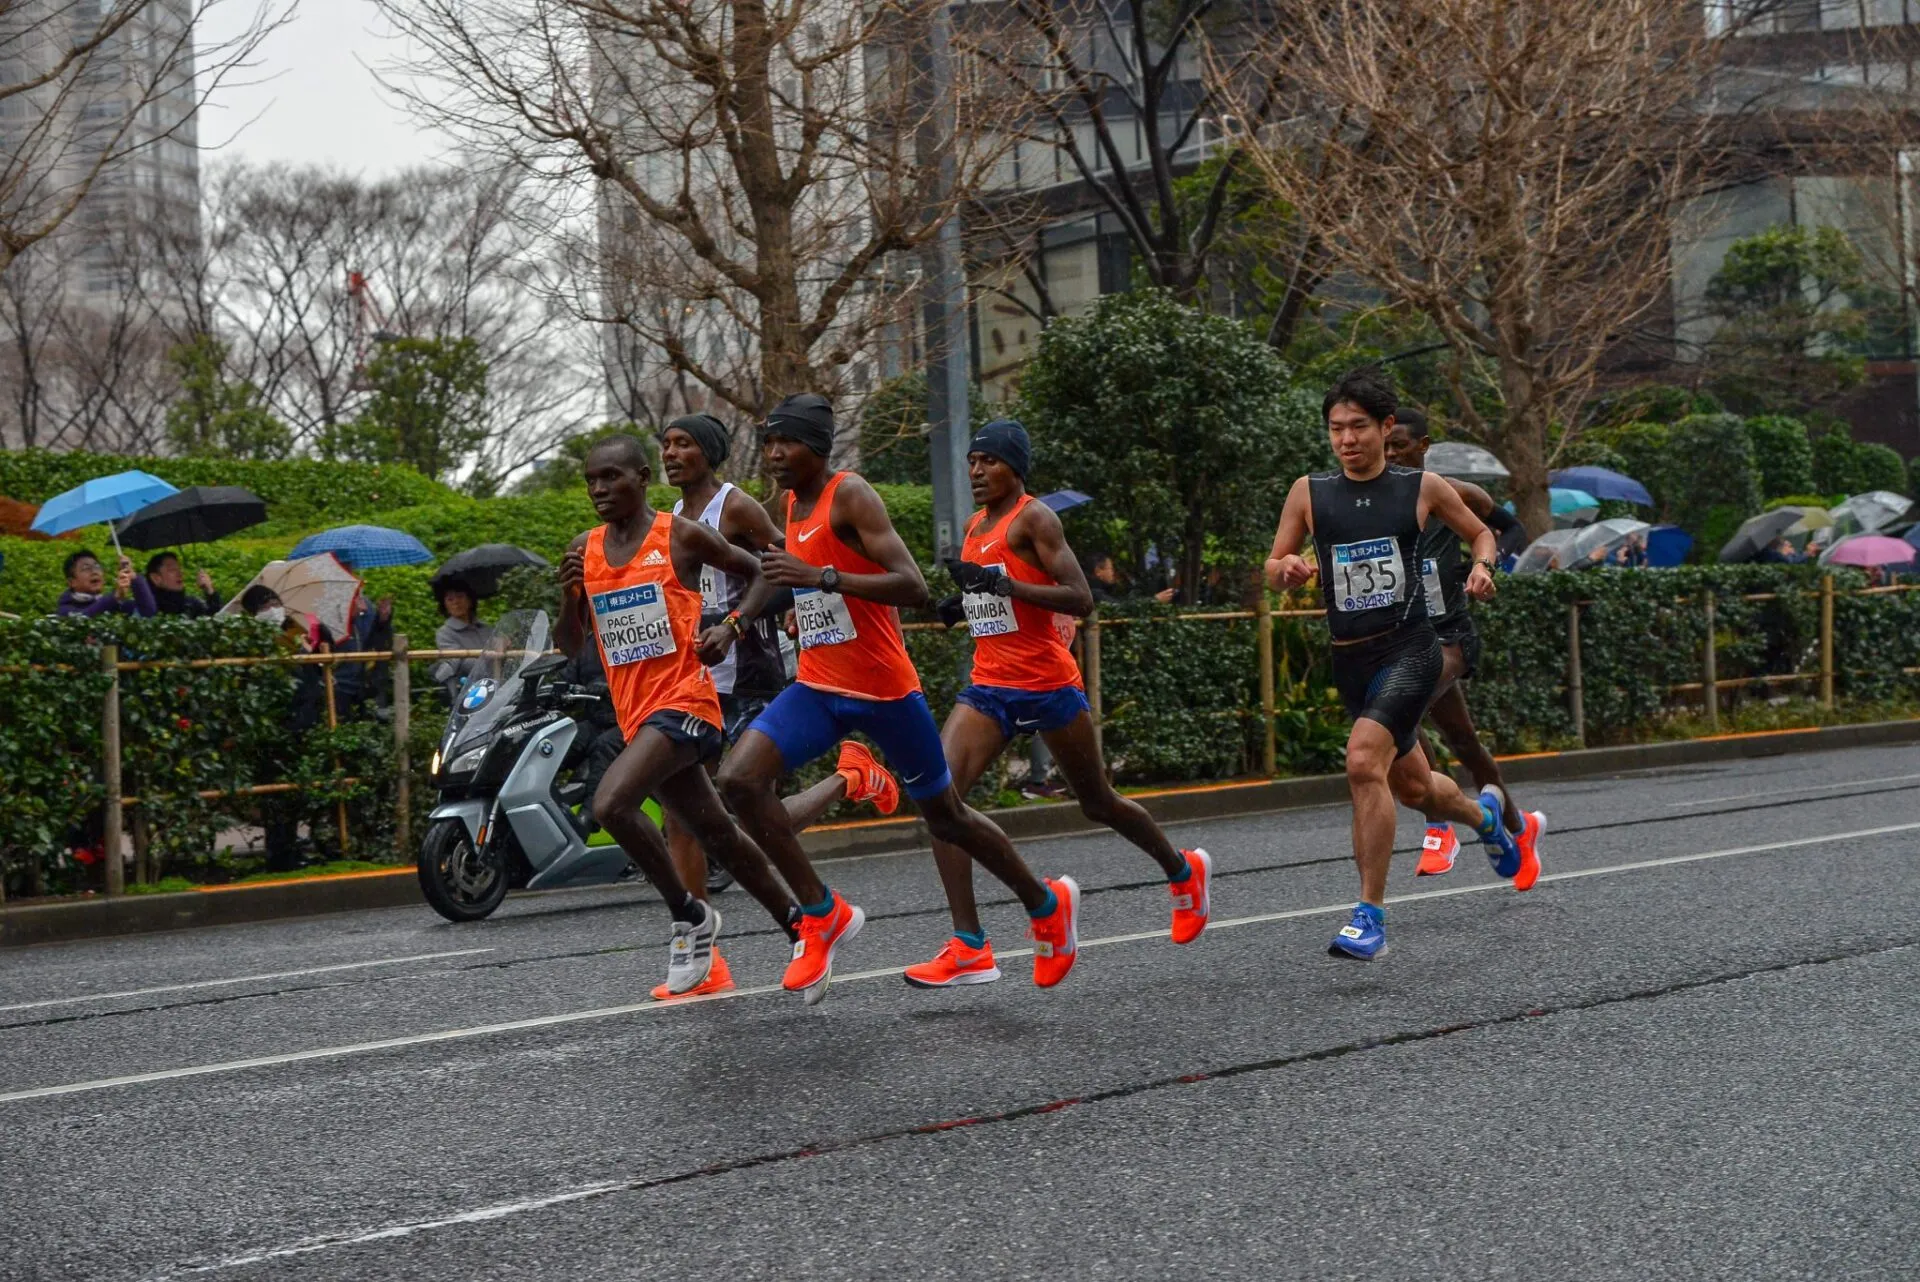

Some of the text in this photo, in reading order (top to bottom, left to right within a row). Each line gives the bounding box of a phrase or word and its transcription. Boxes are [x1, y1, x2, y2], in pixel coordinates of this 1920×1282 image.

[1343, 559, 1396, 596] 135
[609, 590, 653, 607] 東京メトロ
[797, 598, 824, 612] PACE 3
[965, 601, 1008, 620] HUMBA
[607, 614, 636, 629] PACE
[800, 609, 836, 632] OECH
[600, 620, 669, 649] KIPKOECH
[503, 724, 522, 736] BMW
